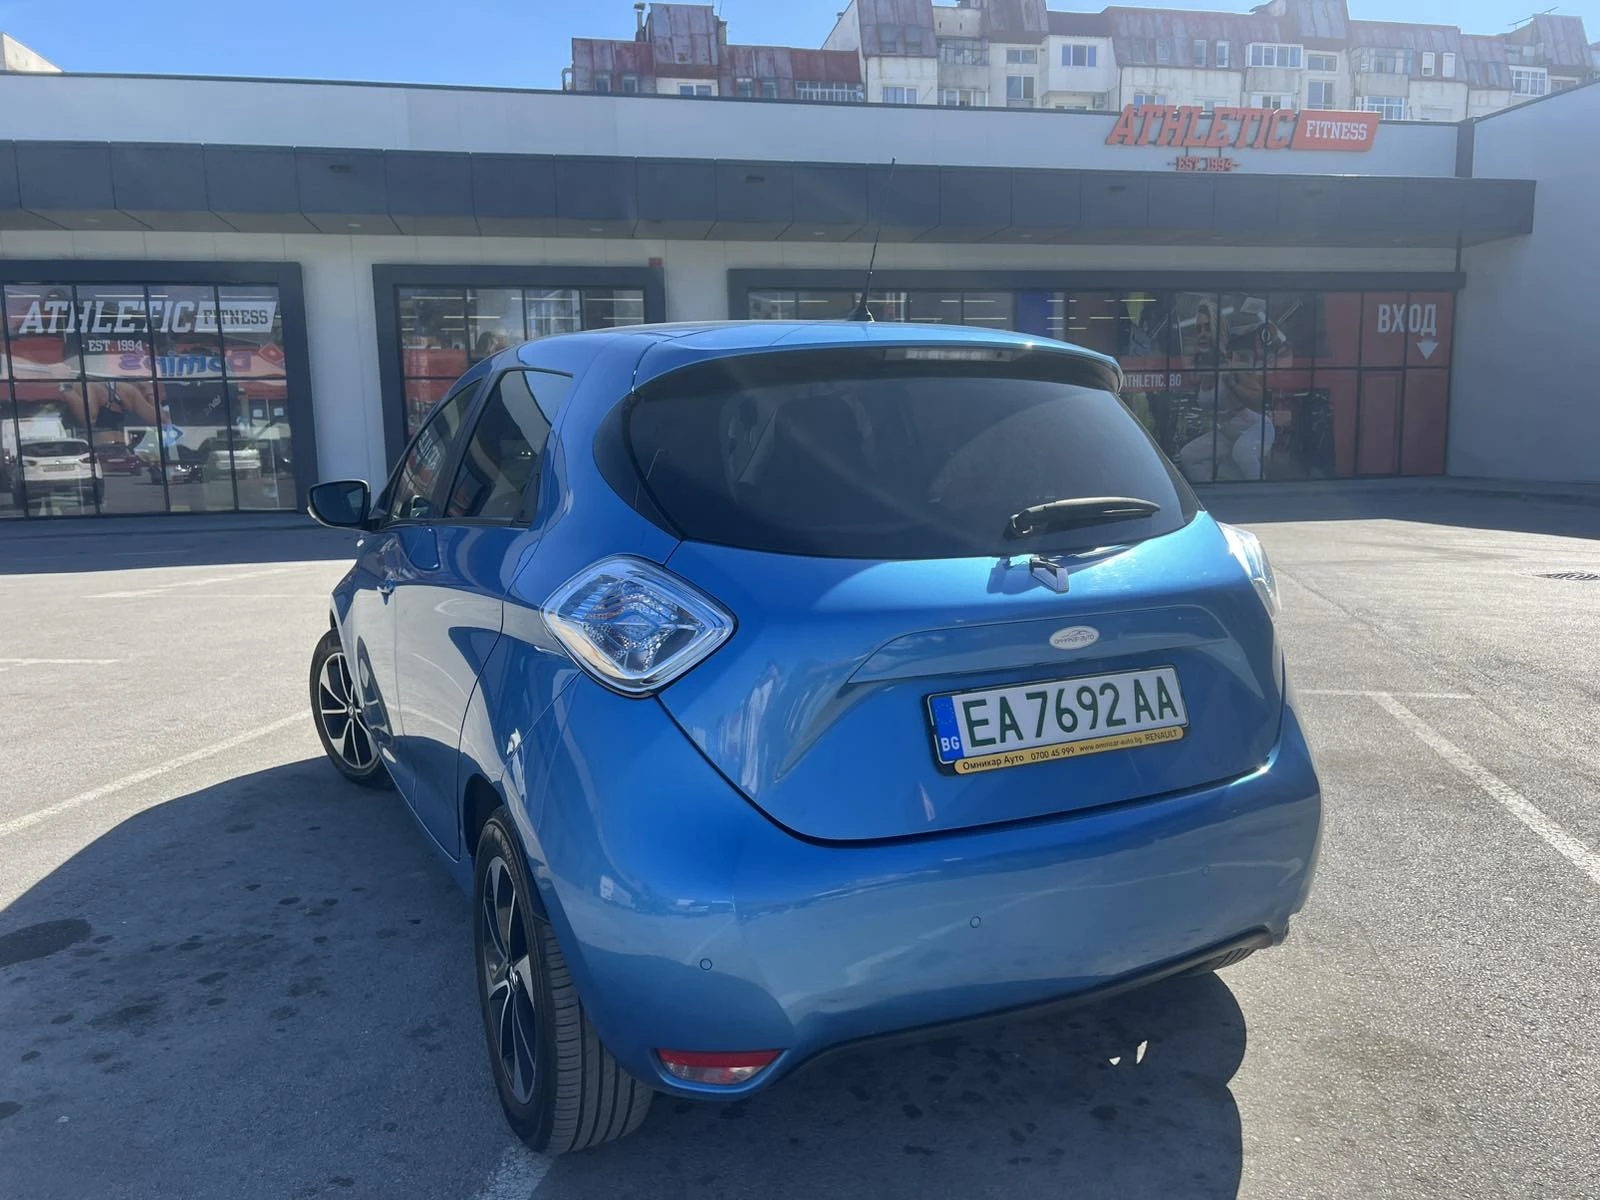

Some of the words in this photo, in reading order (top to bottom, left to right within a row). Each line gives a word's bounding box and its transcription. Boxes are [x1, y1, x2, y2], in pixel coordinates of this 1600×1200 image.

[1105, 104, 1297, 149] ATHLETIC
[1305, 120, 1368, 141] FITNESS
[1207, 158, 1233, 172] 1994
[19, 301, 195, 334] ATHLETIC
[203, 308, 269, 325] FITNESS
[1376, 303, 1438, 337] ВХОД
[117, 339, 144, 352] 1994
[941, 735, 960, 752] BG
[1144, 729, 1178, 742] RENAULT
[1030, 750, 1049, 761] 0700
[1051, 749, 1060, 757] 45
[1061, 746, 1075, 755] 999
[962, 758, 1002, 771] Омникар
[1004, 755, 1024, 766] Ауто
